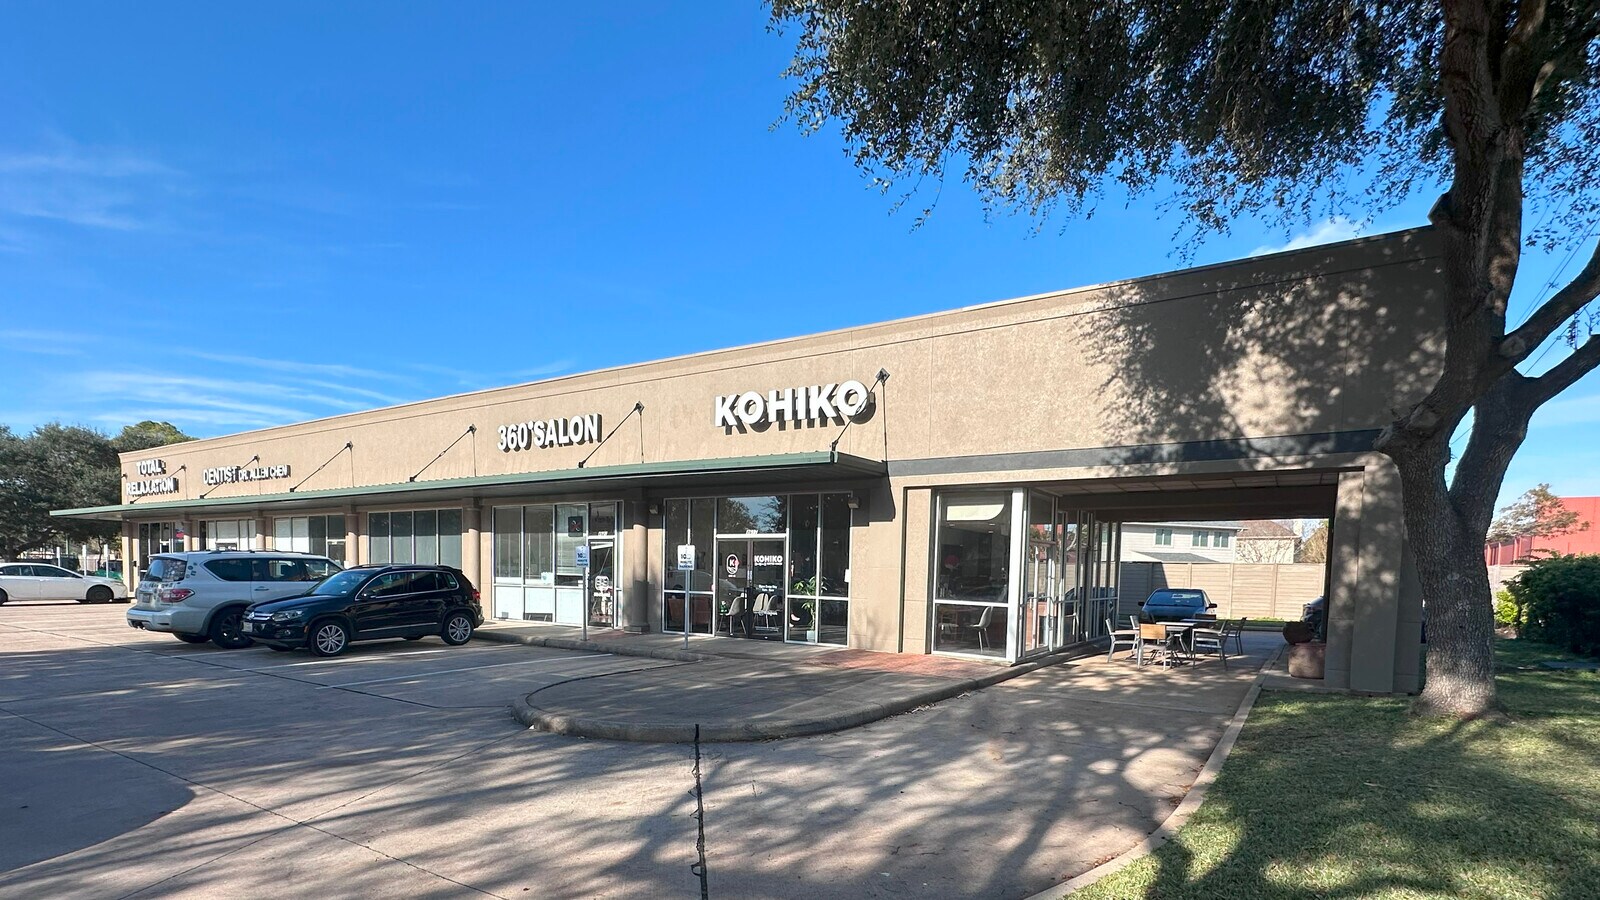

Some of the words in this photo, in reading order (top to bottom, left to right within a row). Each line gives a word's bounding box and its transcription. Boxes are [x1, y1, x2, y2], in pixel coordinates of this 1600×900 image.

[715, 380, 869, 427] KOHIKO
[136, 459, 163, 475] TOTAL
[203, 465, 238, 484] DENTIST
[269, 464, 288, 478] CHEN
[126, 477, 175, 496] RELAXATION
[754, 555, 783, 563] KOHIKO
